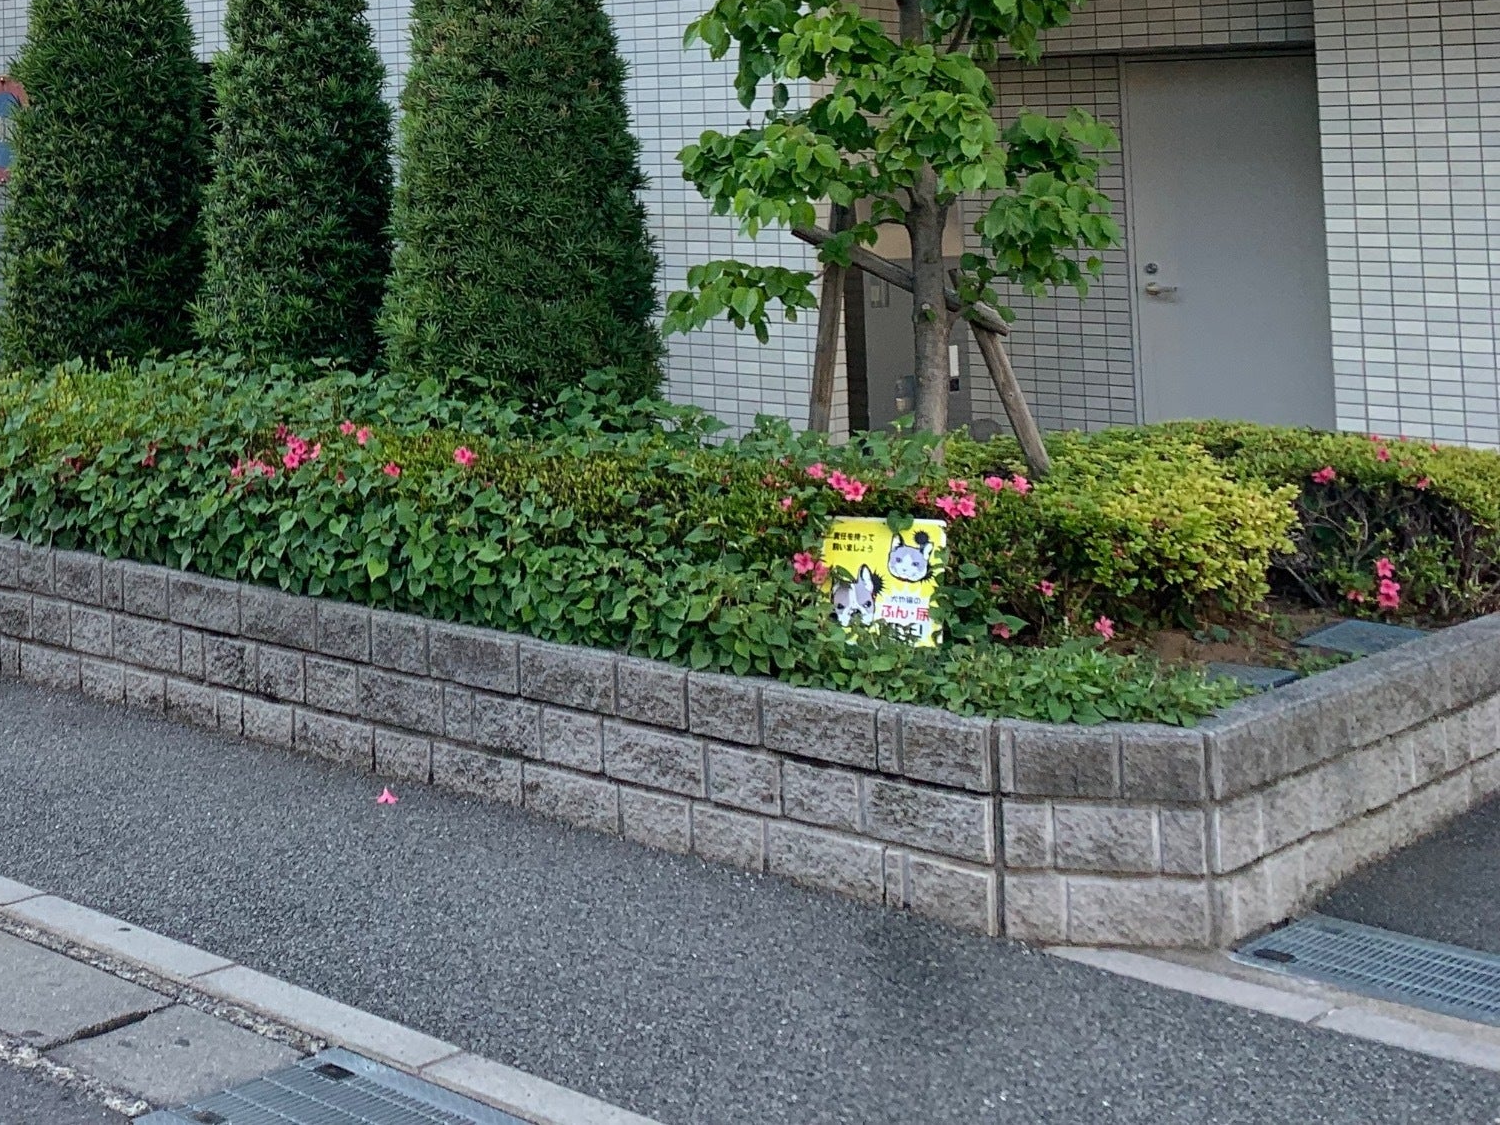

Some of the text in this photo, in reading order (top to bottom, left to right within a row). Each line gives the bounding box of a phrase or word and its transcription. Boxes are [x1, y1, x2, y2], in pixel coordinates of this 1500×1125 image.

[833, 531, 875, 542] 責任を持って
[832, 542, 874, 553] 飼いましょう
